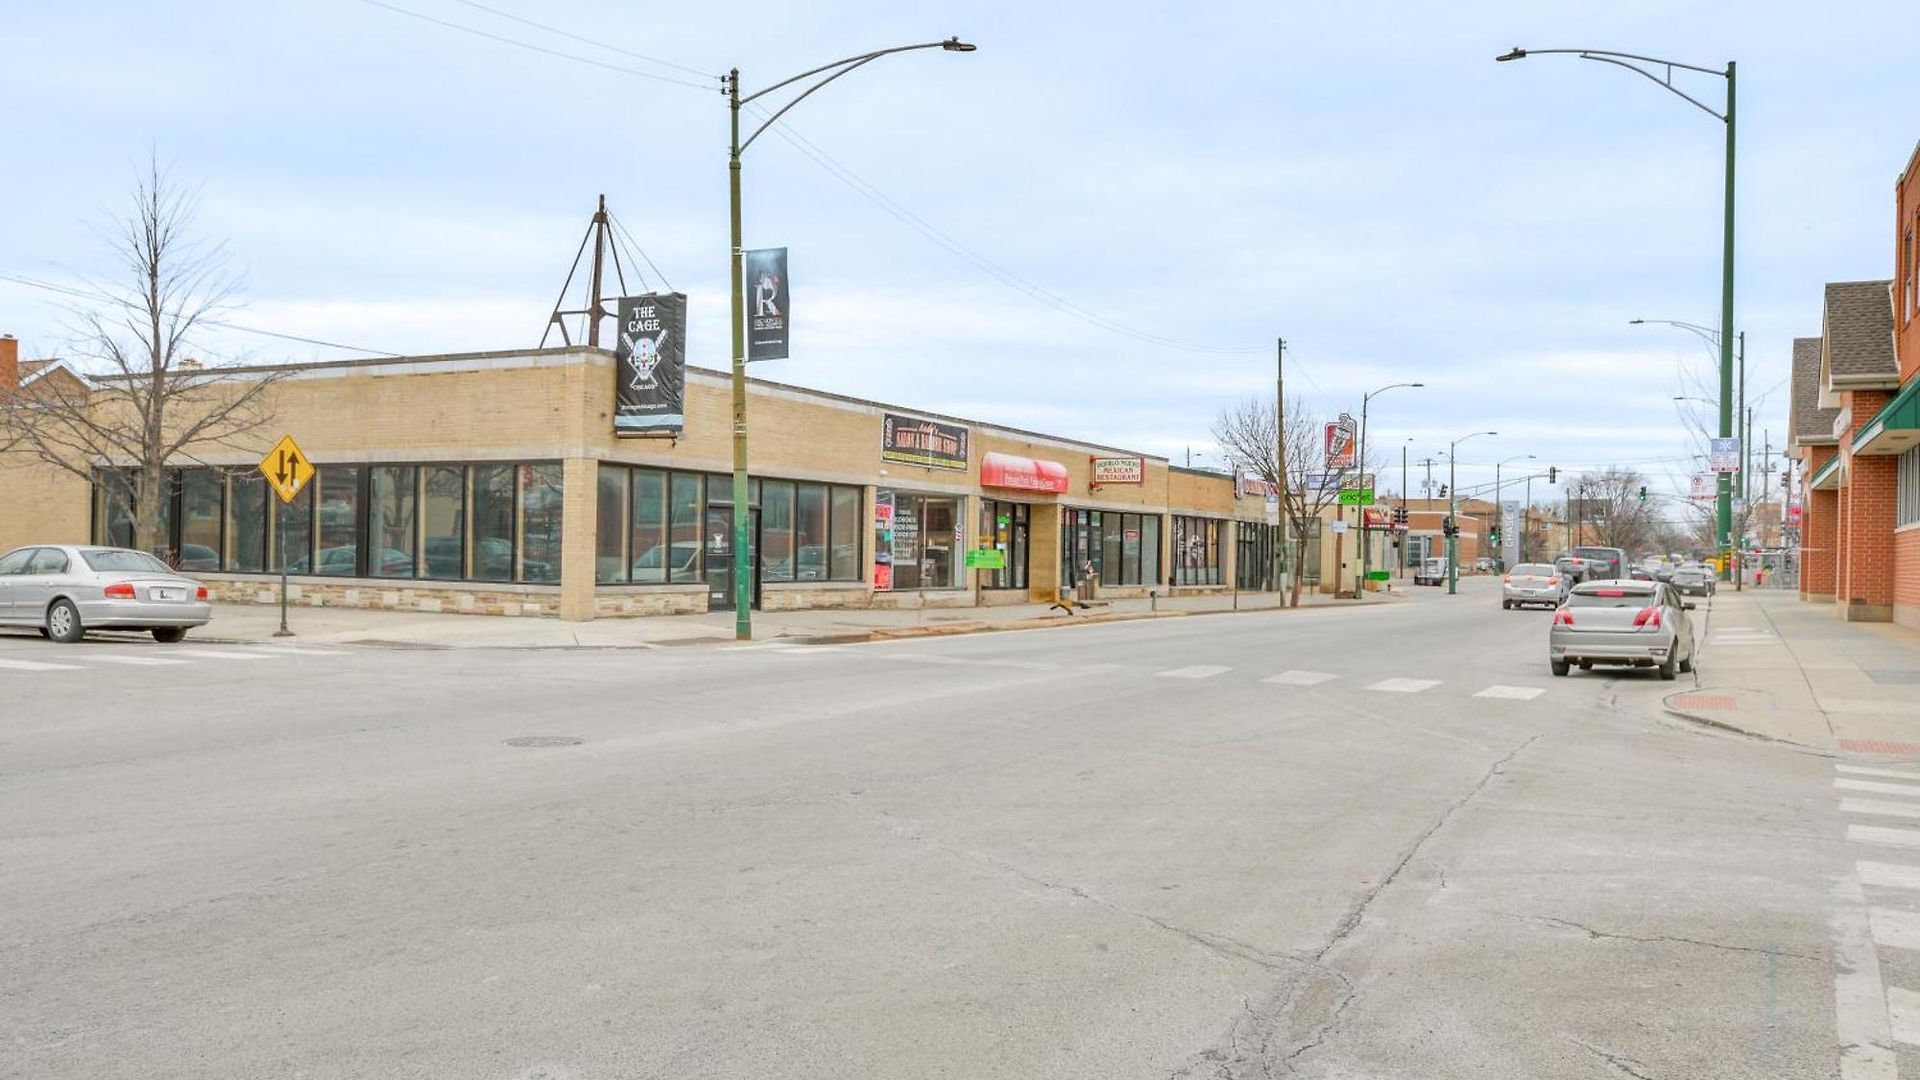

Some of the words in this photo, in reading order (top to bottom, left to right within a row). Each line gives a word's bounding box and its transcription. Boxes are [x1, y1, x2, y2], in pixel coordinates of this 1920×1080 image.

[633, 306, 656, 319] THE
[628, 319, 660, 333] CAGE
[1505, 513, 1514, 548] CHASE
